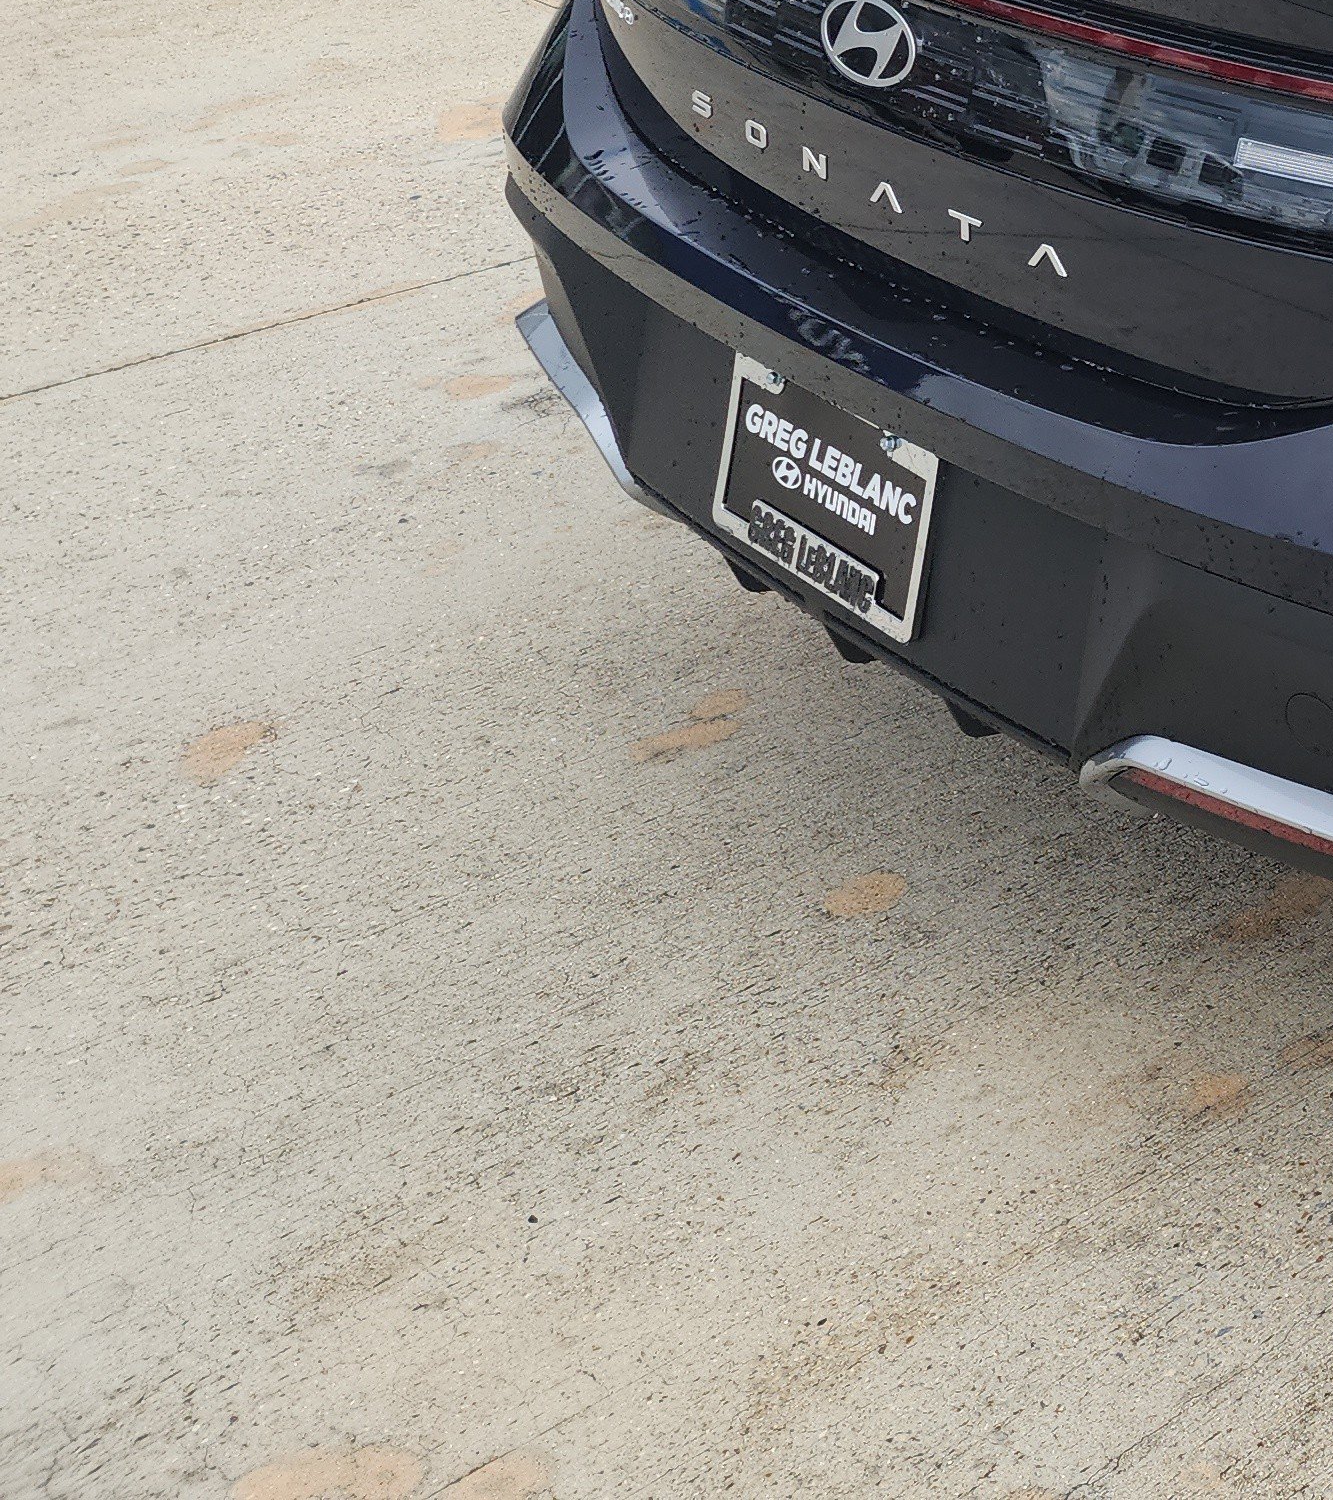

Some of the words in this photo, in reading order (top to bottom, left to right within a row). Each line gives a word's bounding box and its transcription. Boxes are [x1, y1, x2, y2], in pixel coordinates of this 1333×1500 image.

[691, 89, 1069, 278] SONATA
[745, 403, 809, 459] GREG
[808, 438, 917, 525] LEBLANC
[803, 473, 877, 536] HYUNDAI
